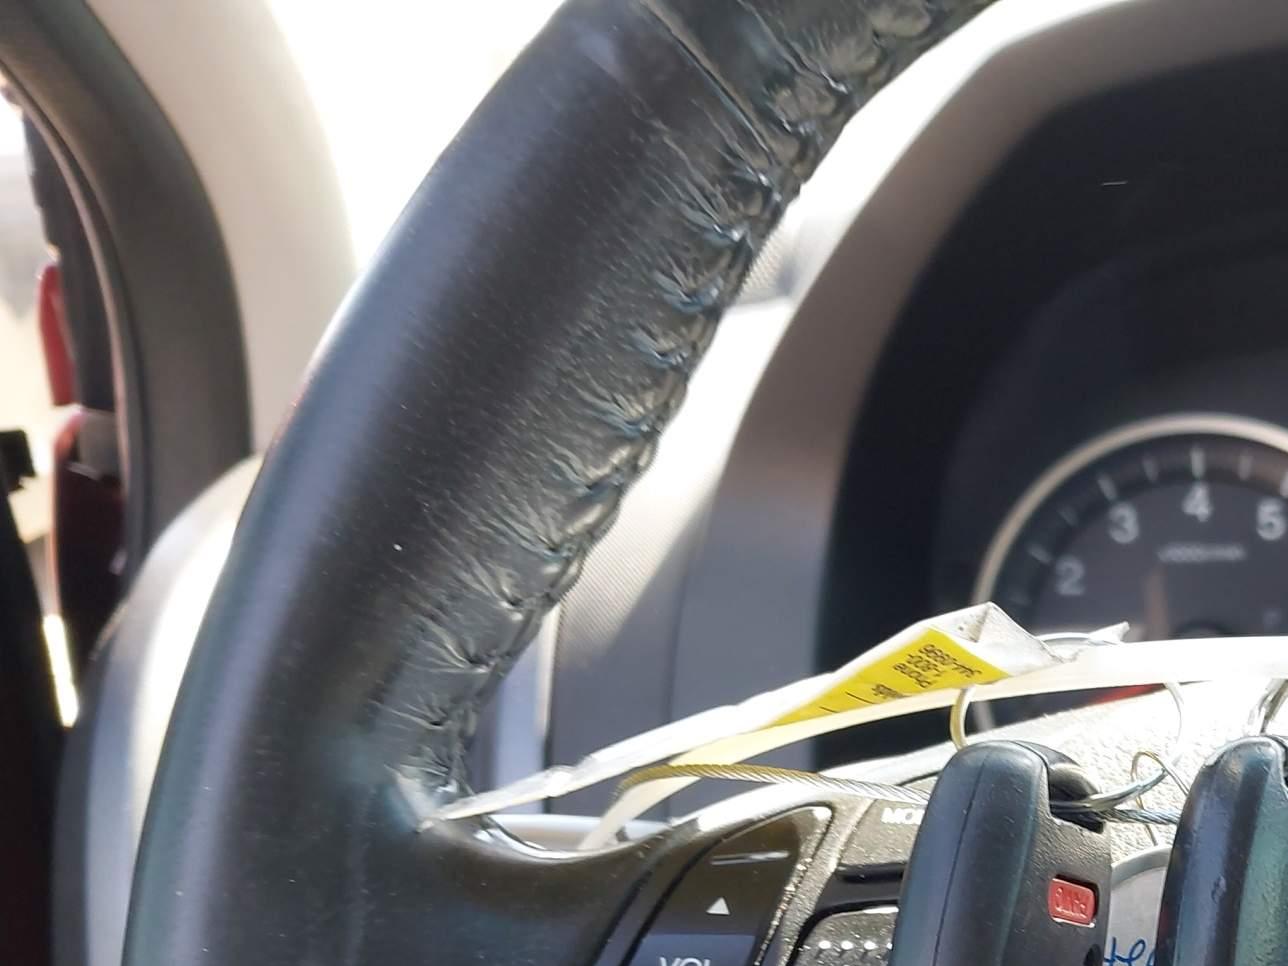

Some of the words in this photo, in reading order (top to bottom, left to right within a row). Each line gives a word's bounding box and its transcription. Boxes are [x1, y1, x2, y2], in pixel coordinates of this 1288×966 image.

[1183, 484, 1212, 522] 4
[1256, 500, 1287, 541] 5
[1108, 503, 1140, 544] 3
[1054, 558, 1086, 597] 2
